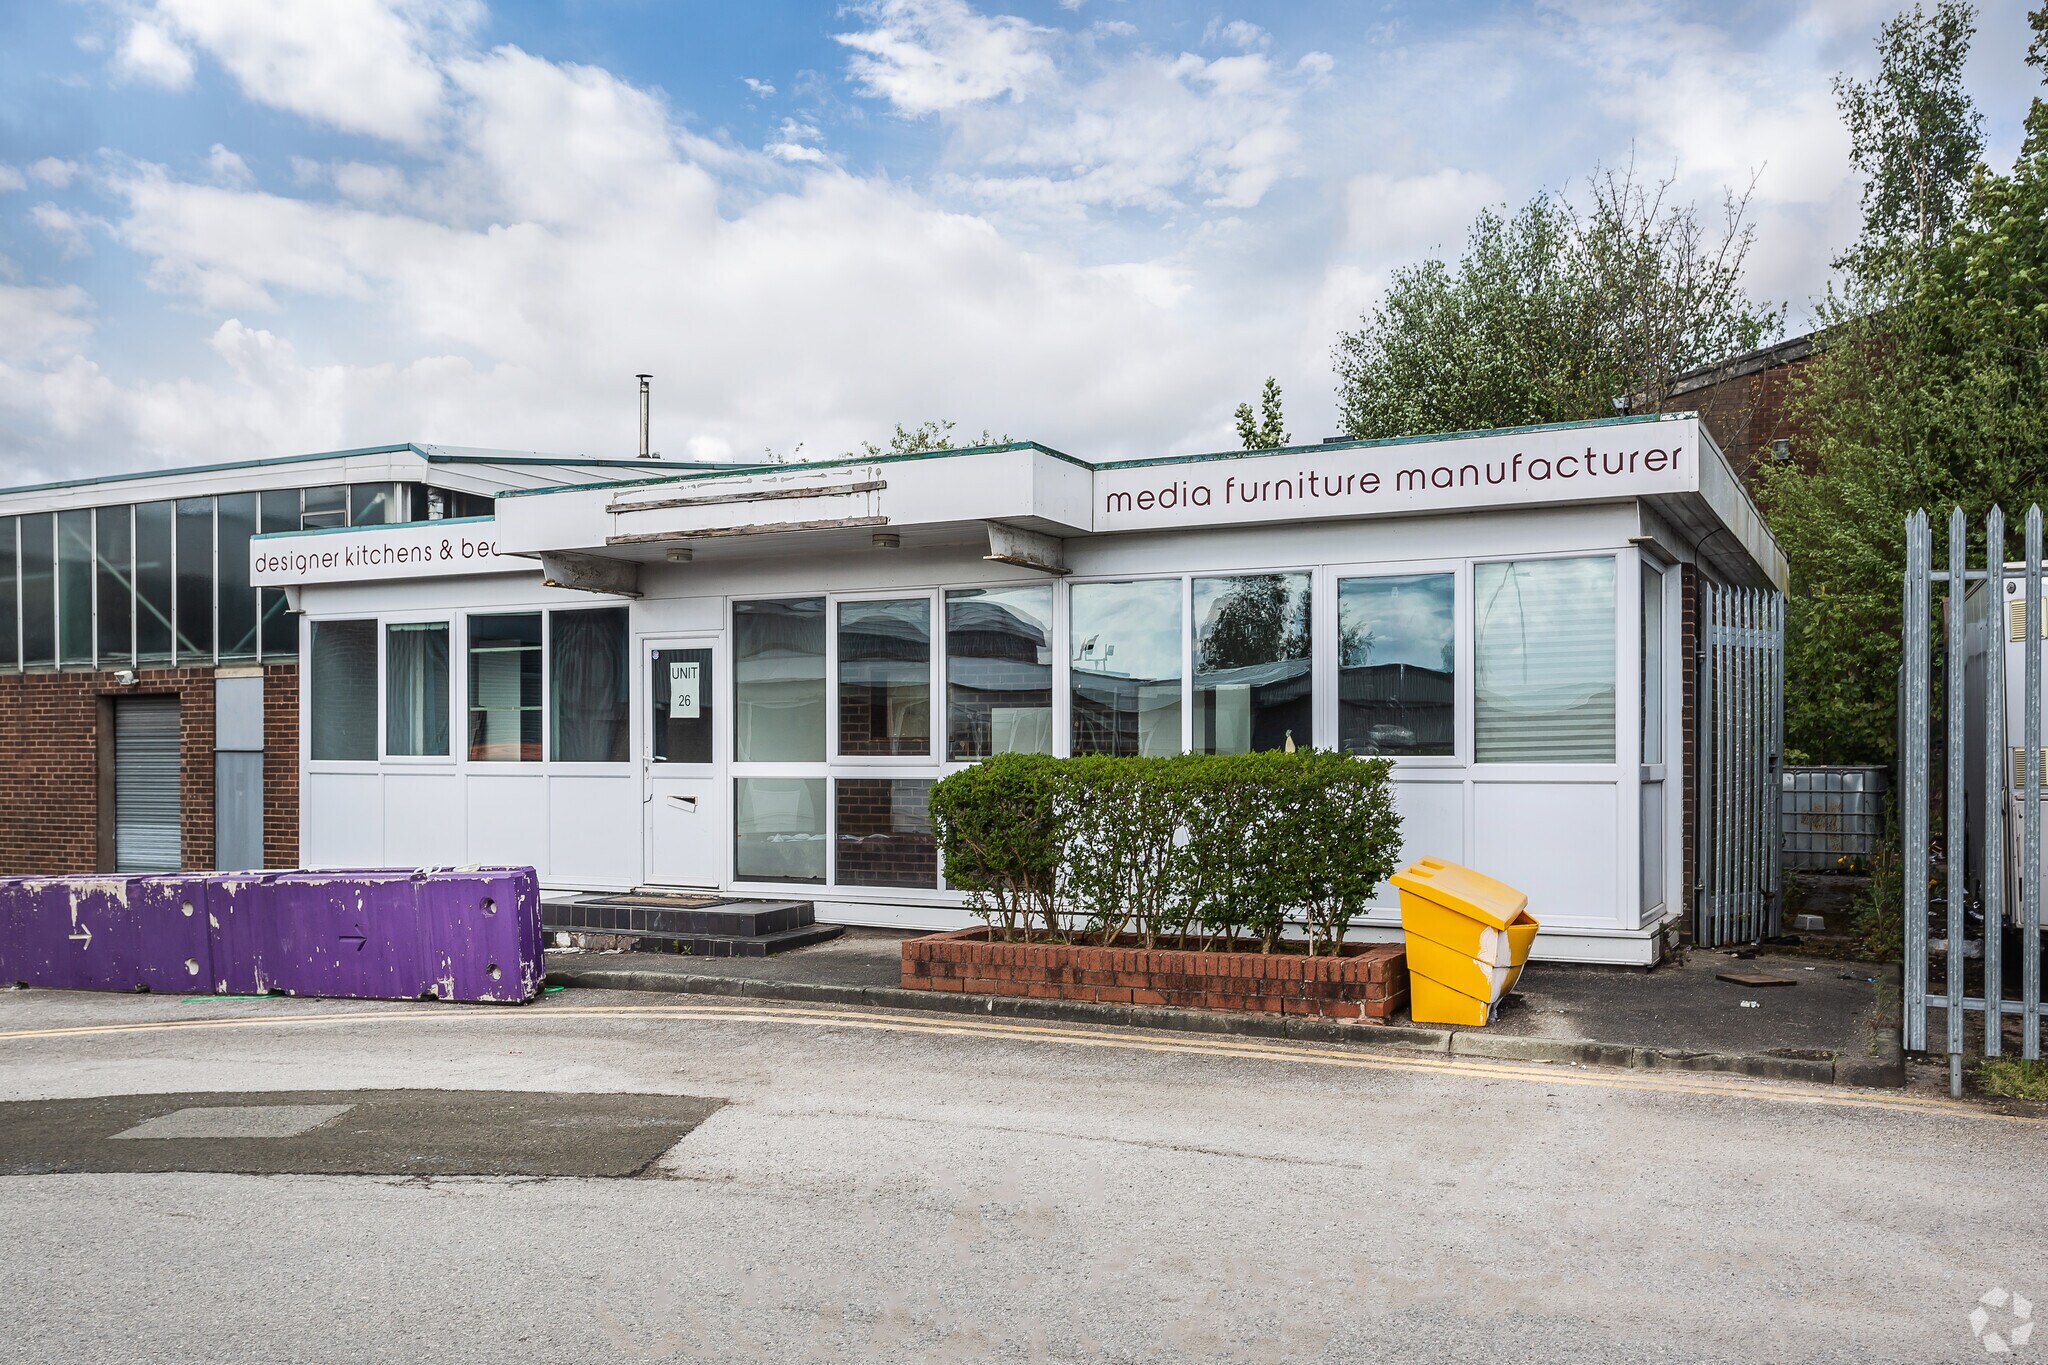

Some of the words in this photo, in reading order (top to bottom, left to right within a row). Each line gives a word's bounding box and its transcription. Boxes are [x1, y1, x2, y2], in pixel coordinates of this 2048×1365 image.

[1106, 480, 1211, 513] media
[1226, 470, 1381, 504] furniture
[1396, 446, 1682, 492] manufacturer
[255, 548, 339, 575] designer
[345, 543, 432, 567] kitchens
[439, 538, 454, 560] &
[671, 666, 698, 680] UNIT
[678, 694, 691, 707] 26
